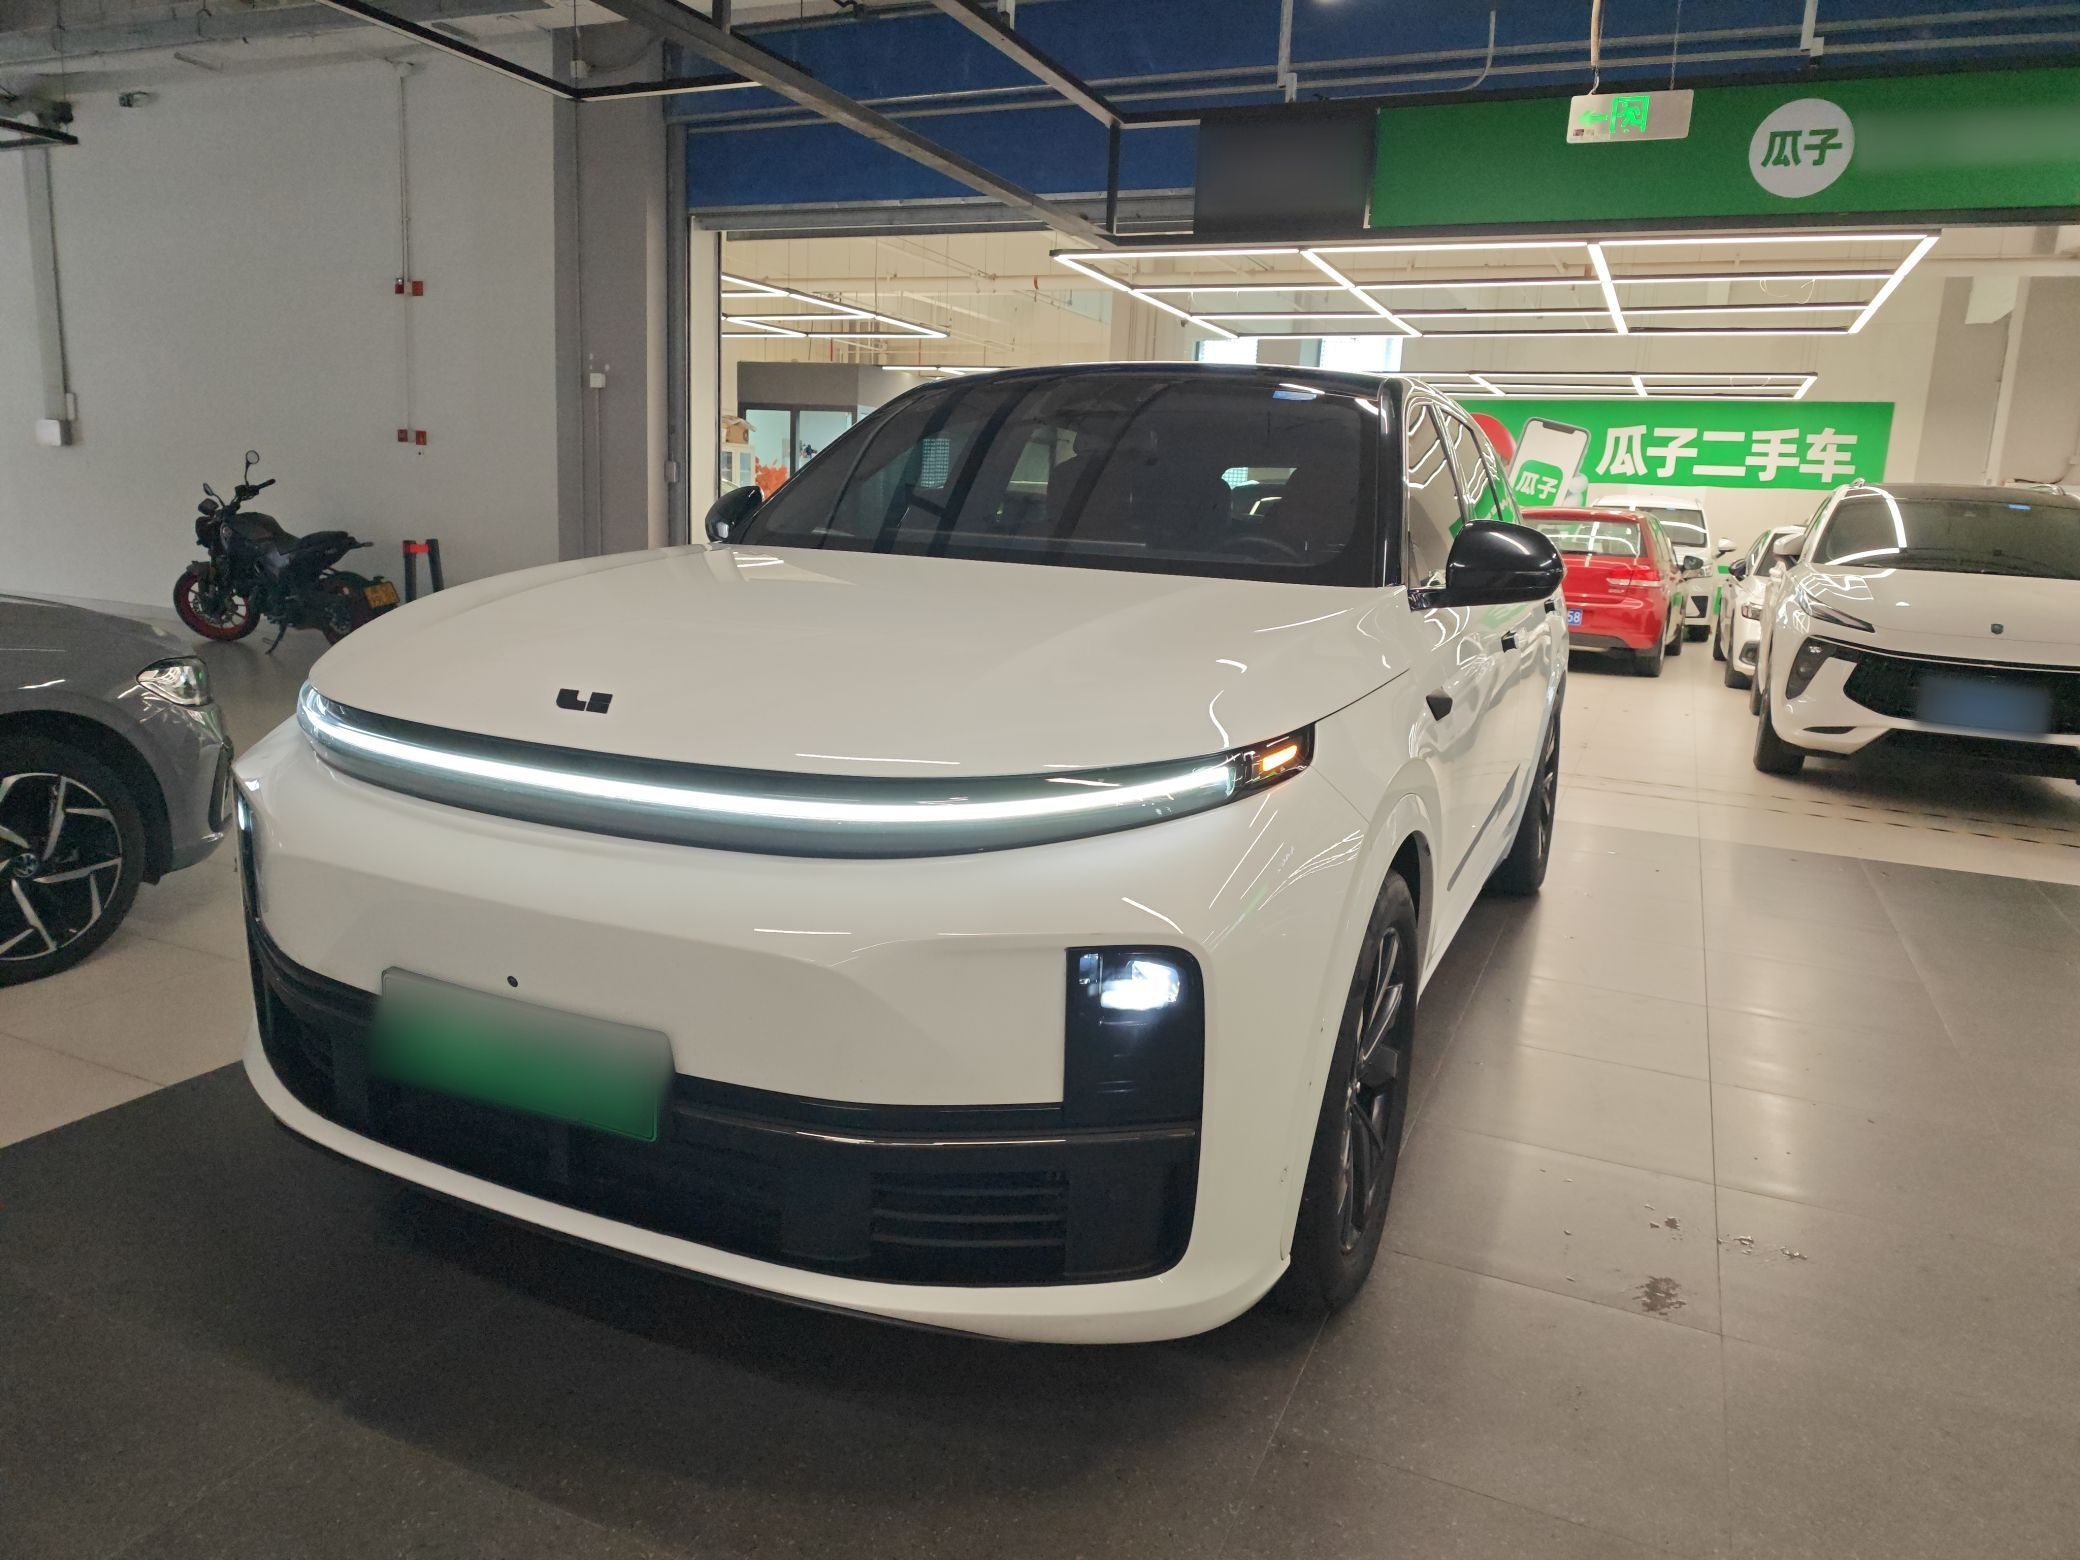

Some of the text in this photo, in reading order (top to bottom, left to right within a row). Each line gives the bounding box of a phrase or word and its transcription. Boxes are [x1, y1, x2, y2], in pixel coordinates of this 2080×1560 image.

[1761, 128, 1843, 168] 瓜子
[1595, 425, 1858, 483] 瓜子二手车
[1515, 471, 1559, 499] 瓜子
